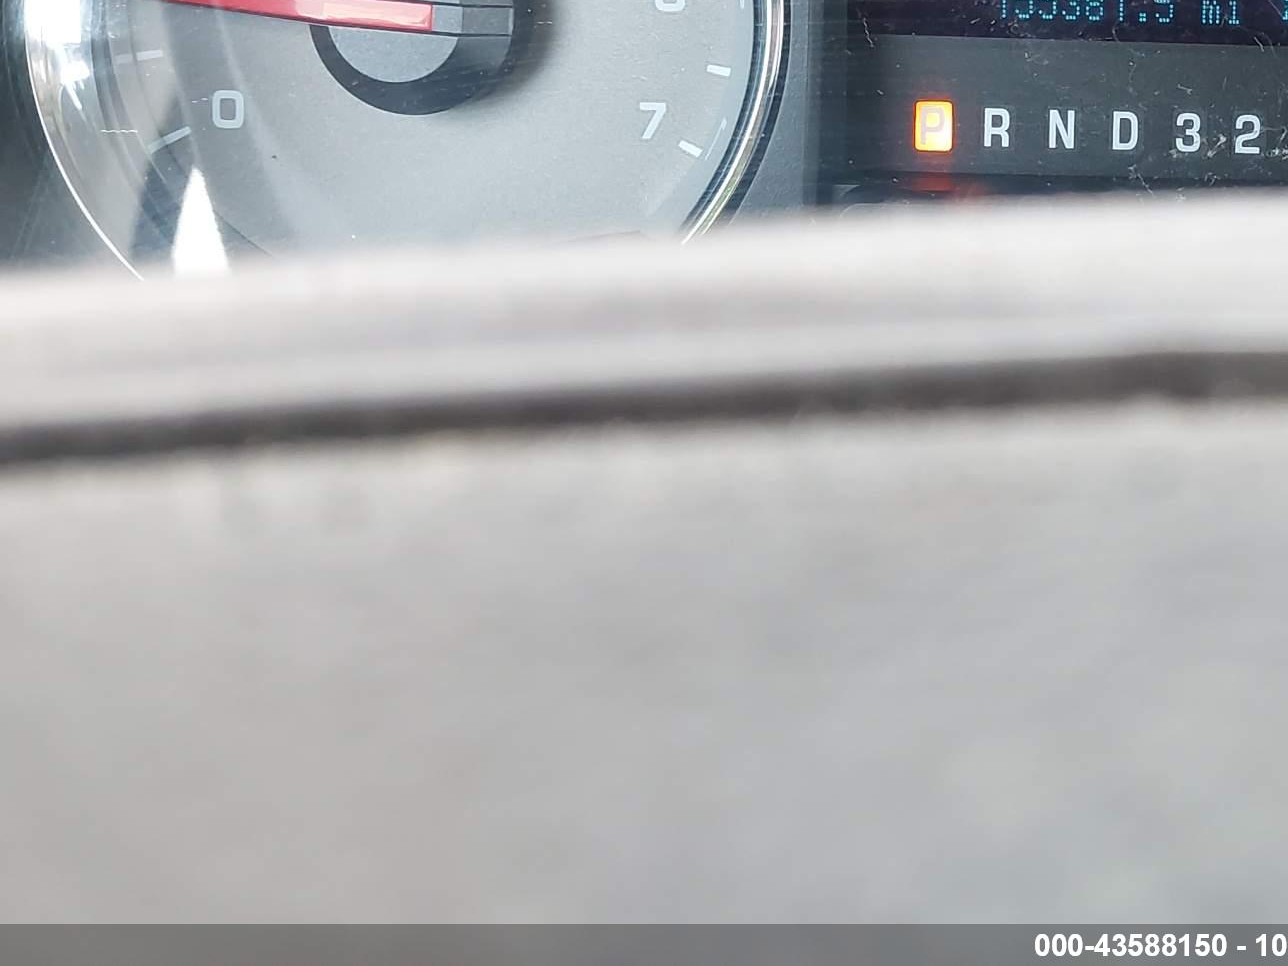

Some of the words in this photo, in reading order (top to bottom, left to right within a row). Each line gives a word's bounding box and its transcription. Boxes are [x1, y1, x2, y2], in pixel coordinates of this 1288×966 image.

[212, 91, 244, 127] 0
[639, 102, 667, 140] 7
[920, 105, 945, 145] P
[984, 108, 1010, 147] R
[1049, 111, 1075, 149] N
[1112, 112, 1139, 150] D
[1176, 113, 1201, 152] 3
[1235, 115, 1261, 153] 2
